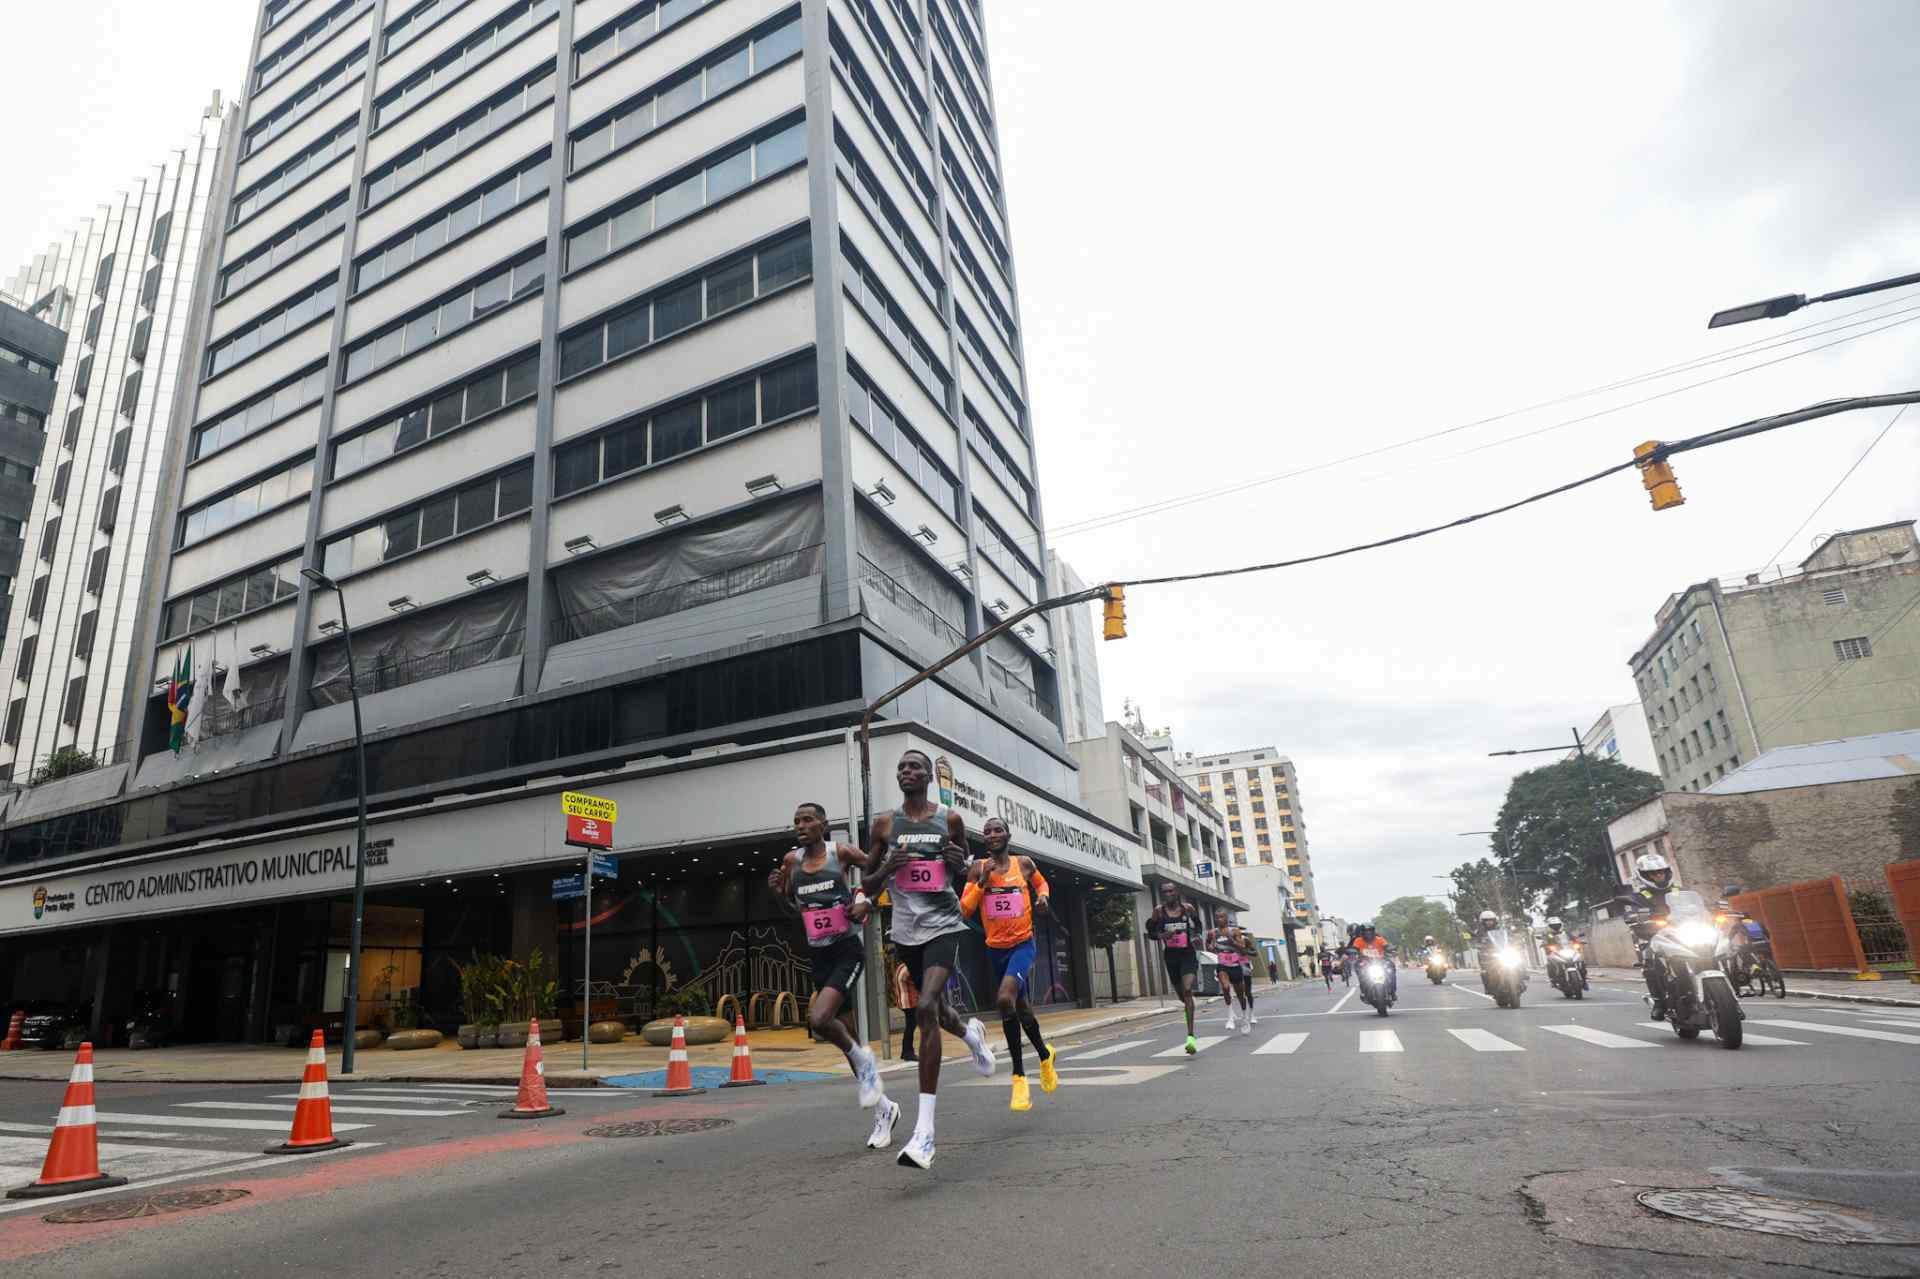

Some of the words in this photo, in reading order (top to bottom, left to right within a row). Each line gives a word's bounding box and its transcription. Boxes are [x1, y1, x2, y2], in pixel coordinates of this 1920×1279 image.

[564, 794, 615, 812] COMPRAMOS
[568, 805, 583, 815] SEU
[584, 807, 609, 819] CARRO
[996, 795, 1038, 835] CENTRO
[1040, 813, 1101, 859] ADMINISTRATIVO
[85, 879, 135, 906] CENTRO
[137, 860, 258, 899] ADMINISTRATIVO
[261, 844, 356, 882] MUNICIPAL
[911, 870, 931, 882] 50
[995, 900, 1012, 911] 52
[814, 917, 833, 930] 62
